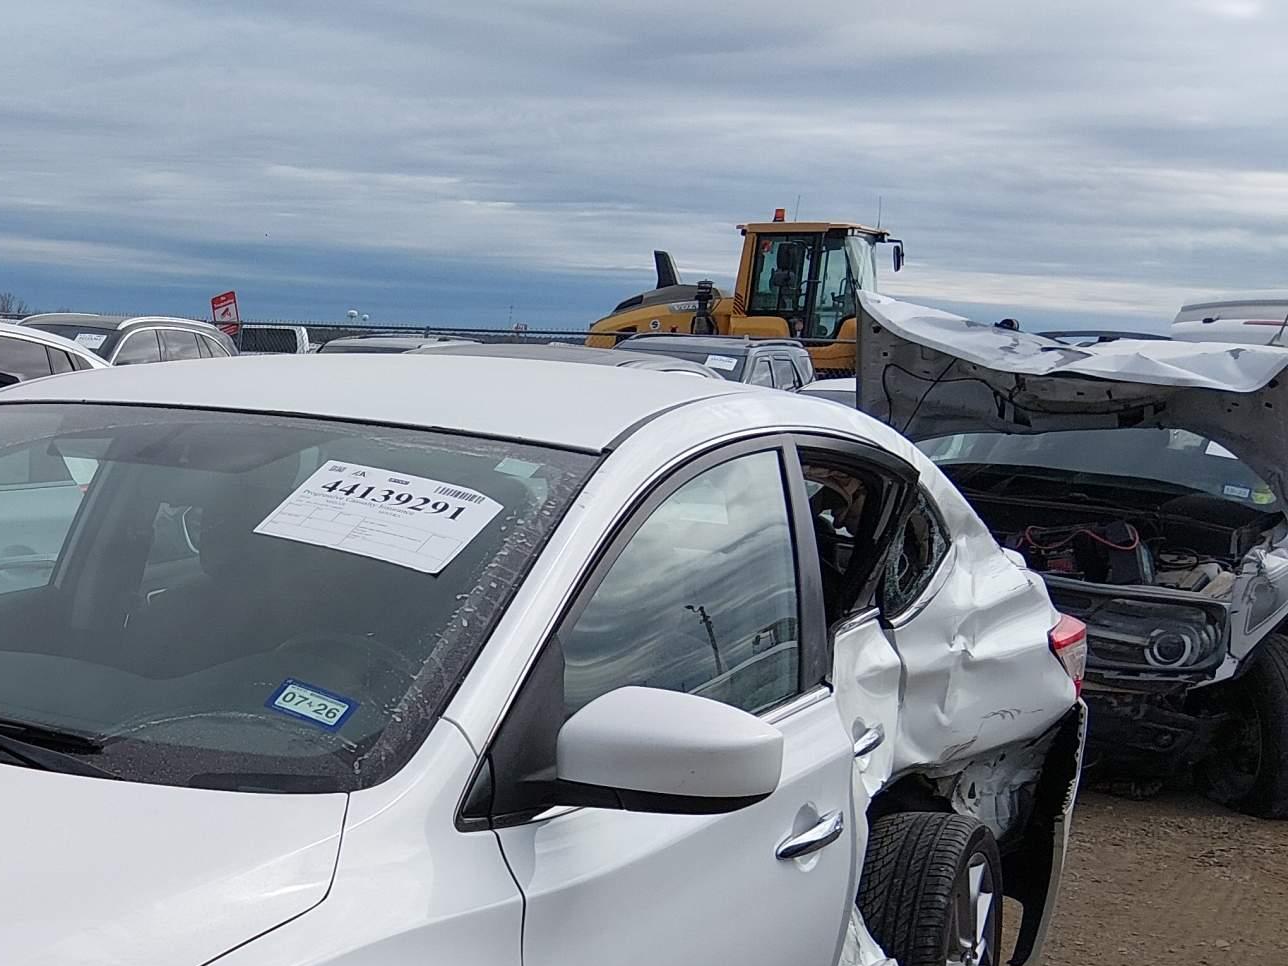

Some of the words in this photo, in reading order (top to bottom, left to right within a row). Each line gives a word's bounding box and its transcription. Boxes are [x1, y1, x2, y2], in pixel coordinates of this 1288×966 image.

[321, 479, 467, 521] 44139291
[282, 691, 309, 707] 07
[312, 703, 340, 720] 26
